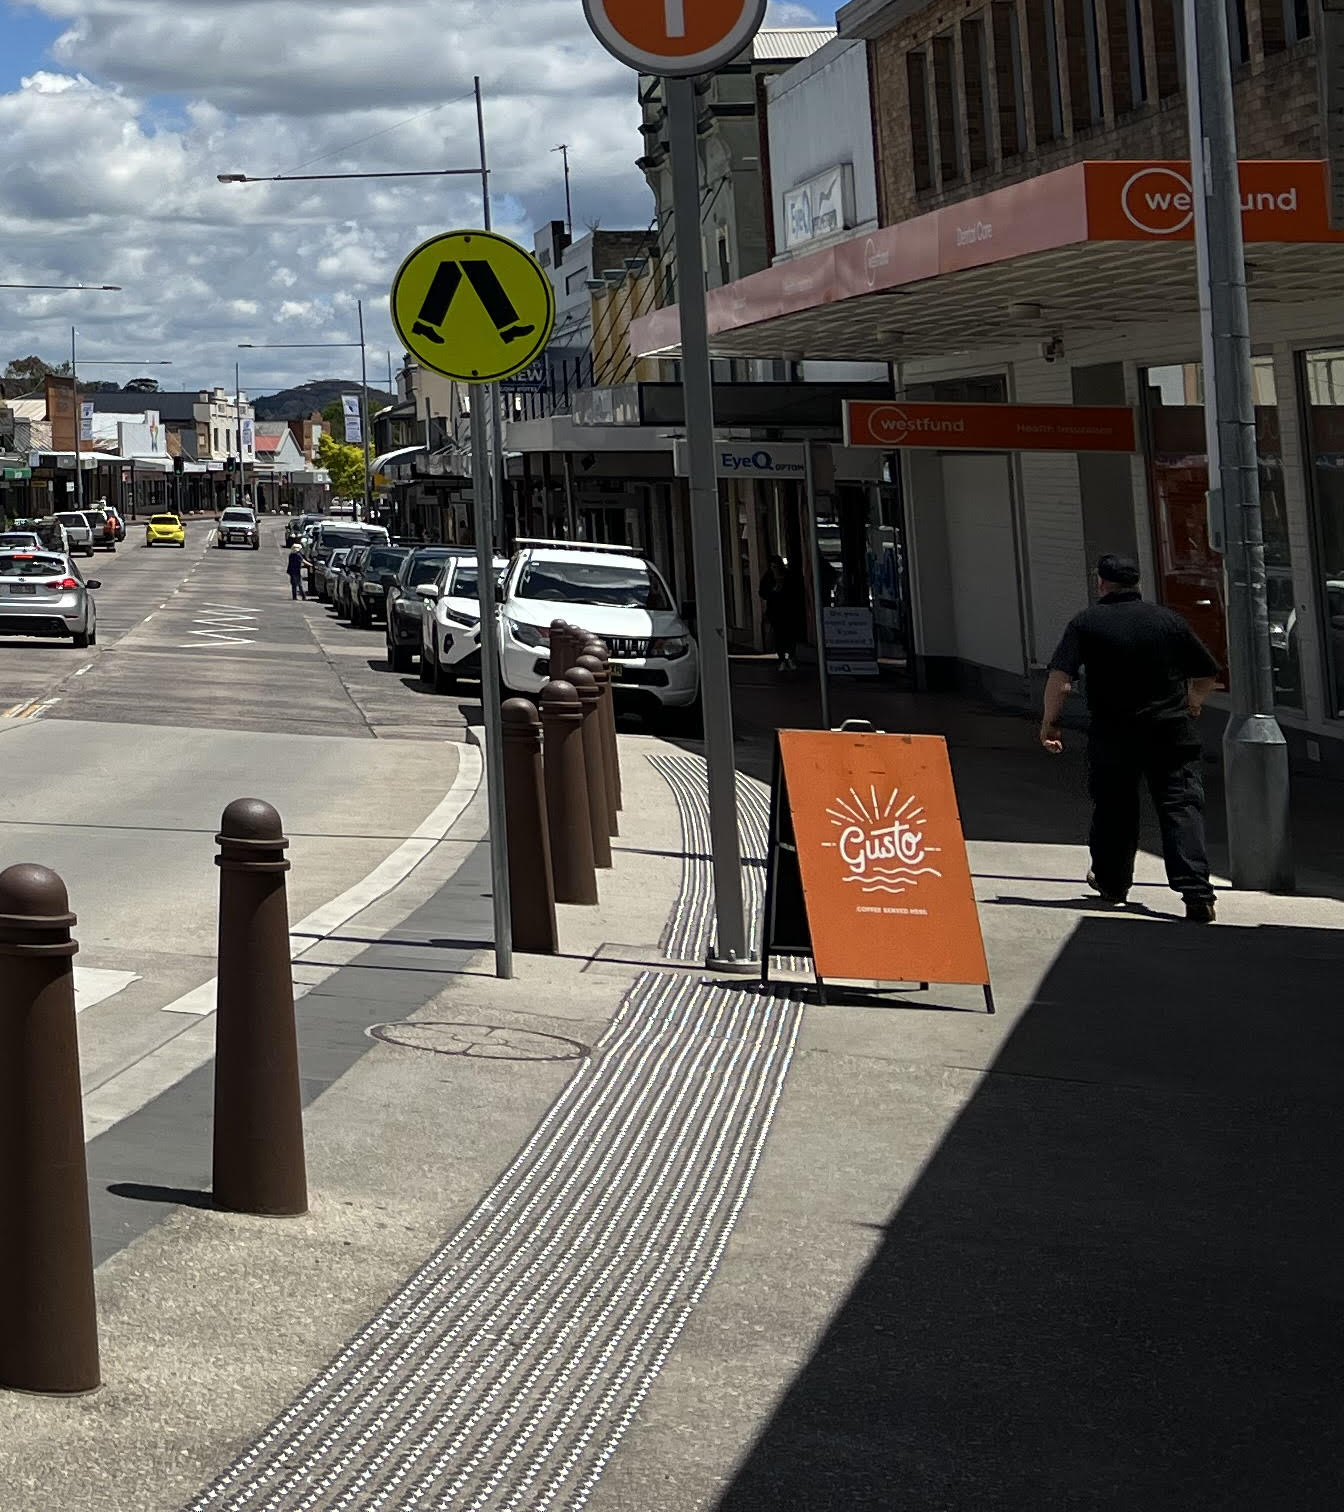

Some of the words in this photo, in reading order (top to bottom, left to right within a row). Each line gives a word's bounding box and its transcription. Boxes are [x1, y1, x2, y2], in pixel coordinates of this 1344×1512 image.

[880, 418, 965, 433] westfund
[721, 451, 773, 470] EyeQ
[839, 820, 926, 873] Gusto
